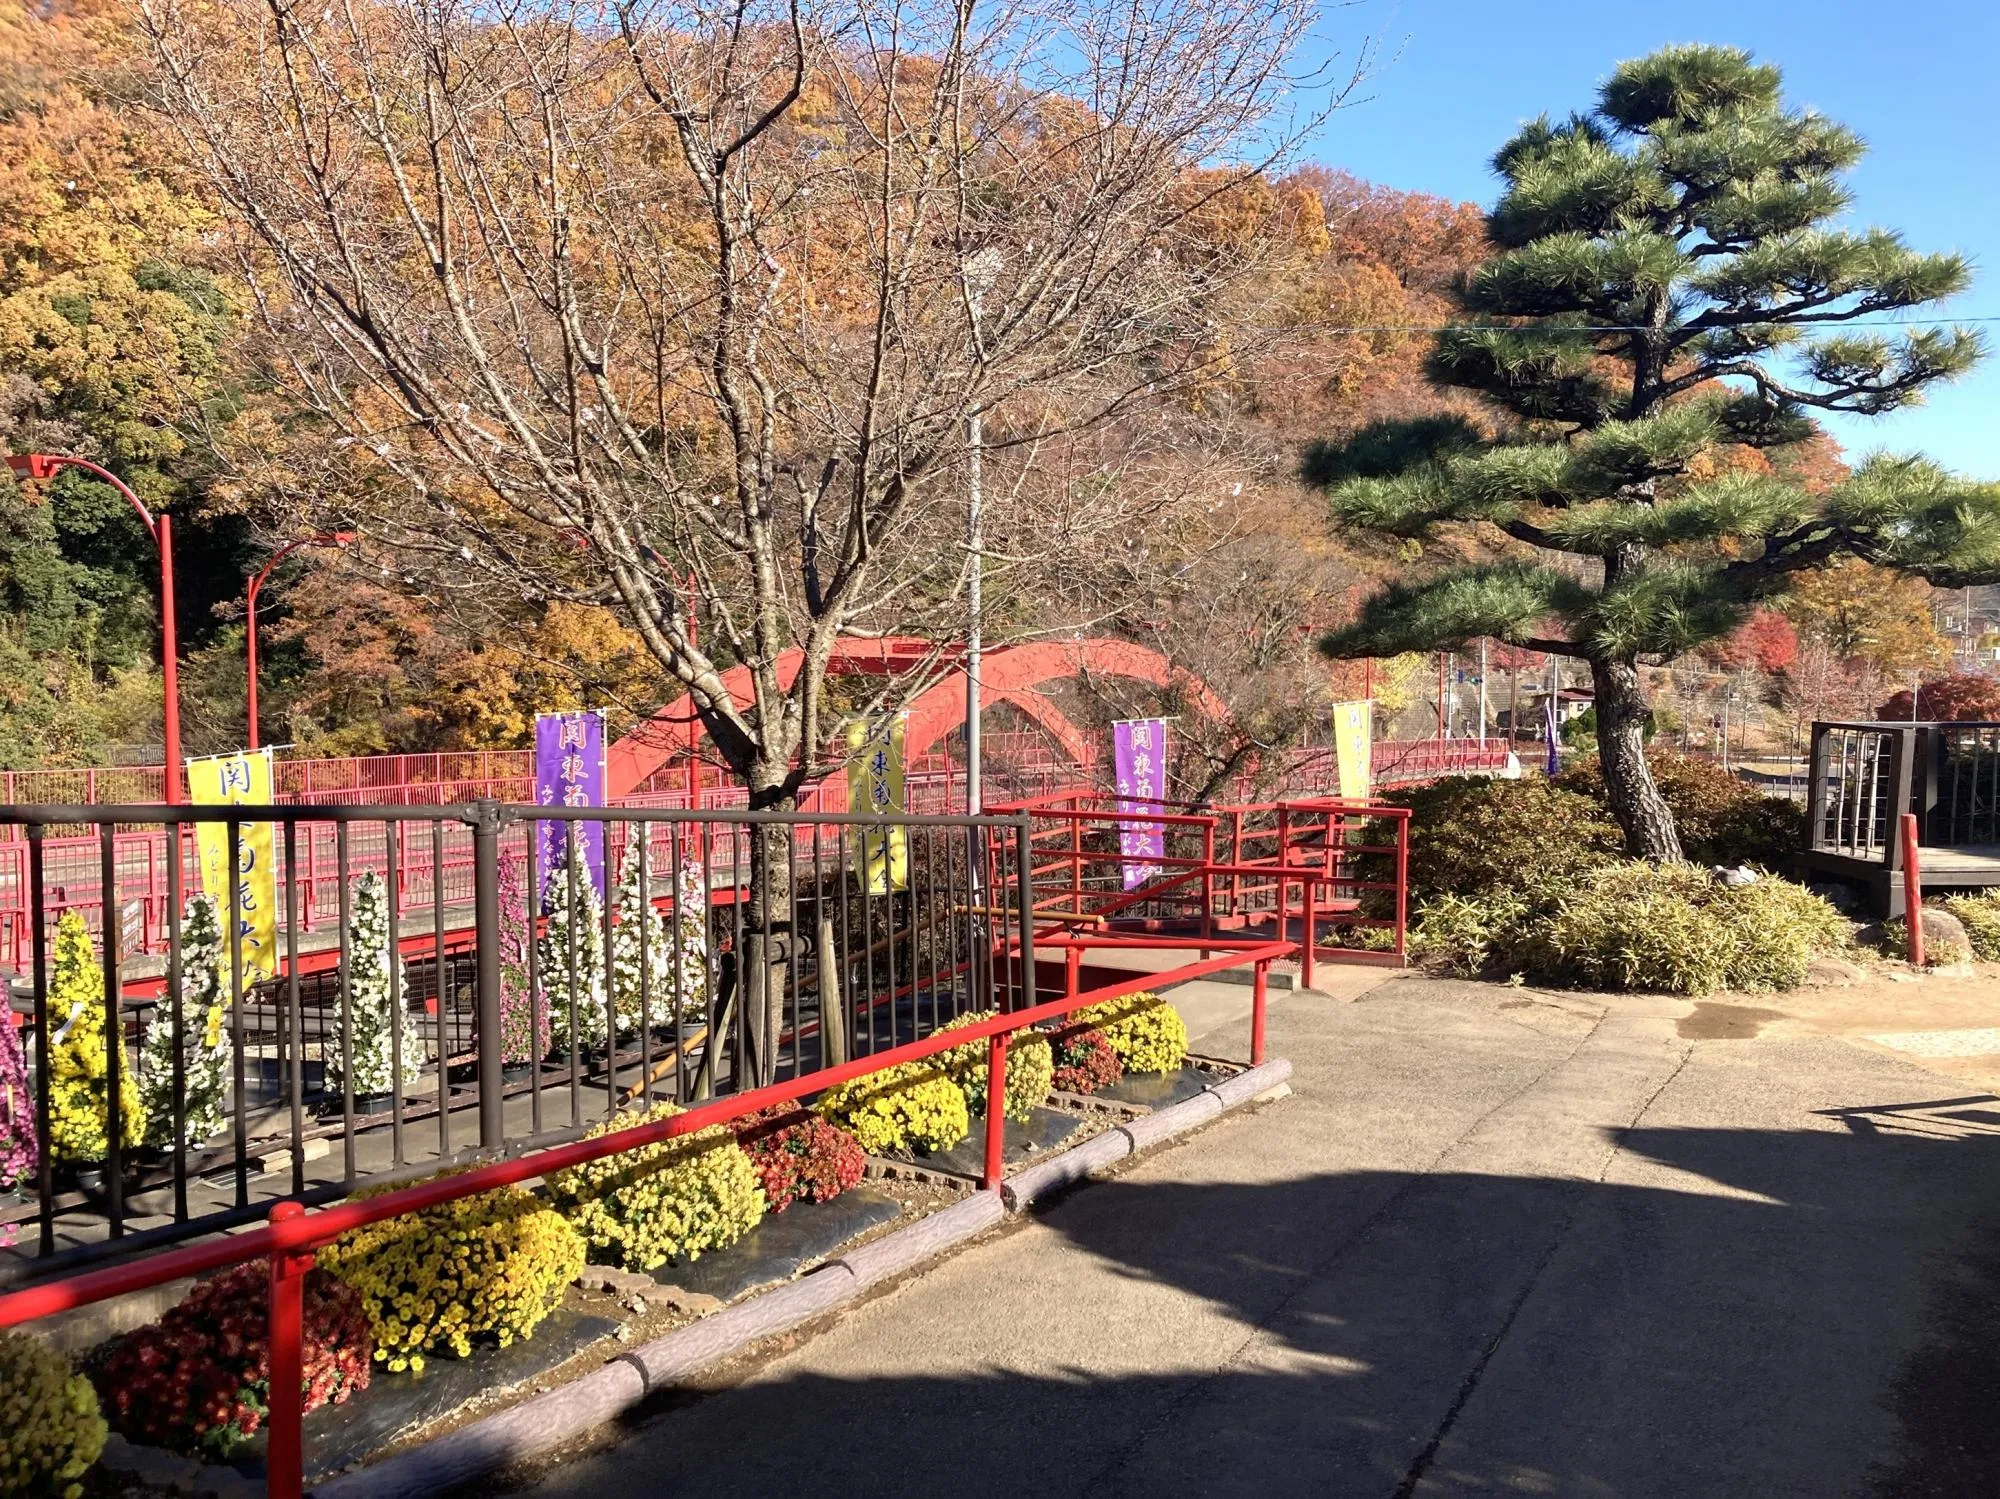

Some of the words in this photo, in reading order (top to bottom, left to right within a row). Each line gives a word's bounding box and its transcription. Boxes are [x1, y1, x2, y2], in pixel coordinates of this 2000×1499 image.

[220, 760, 269, 982] 関菊花大会
